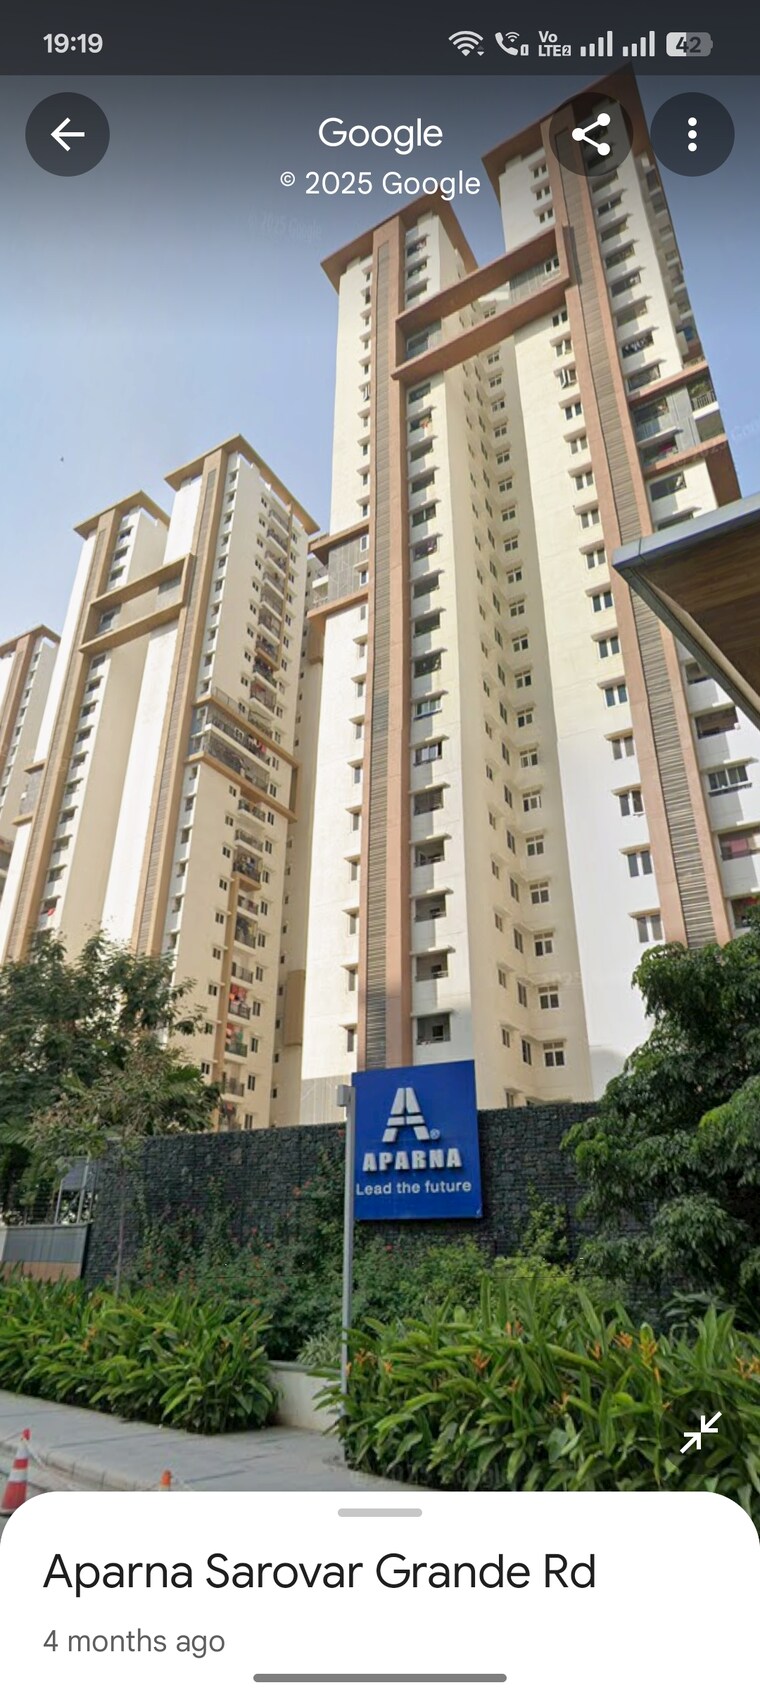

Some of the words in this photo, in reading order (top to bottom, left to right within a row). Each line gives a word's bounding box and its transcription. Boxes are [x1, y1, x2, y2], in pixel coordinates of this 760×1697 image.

[362, 1148, 462, 1172] APARNA
[356, 1182, 392, 1196] Lead
[396, 1181, 421, 1194] the
[425, 1180, 472, 1193] future
